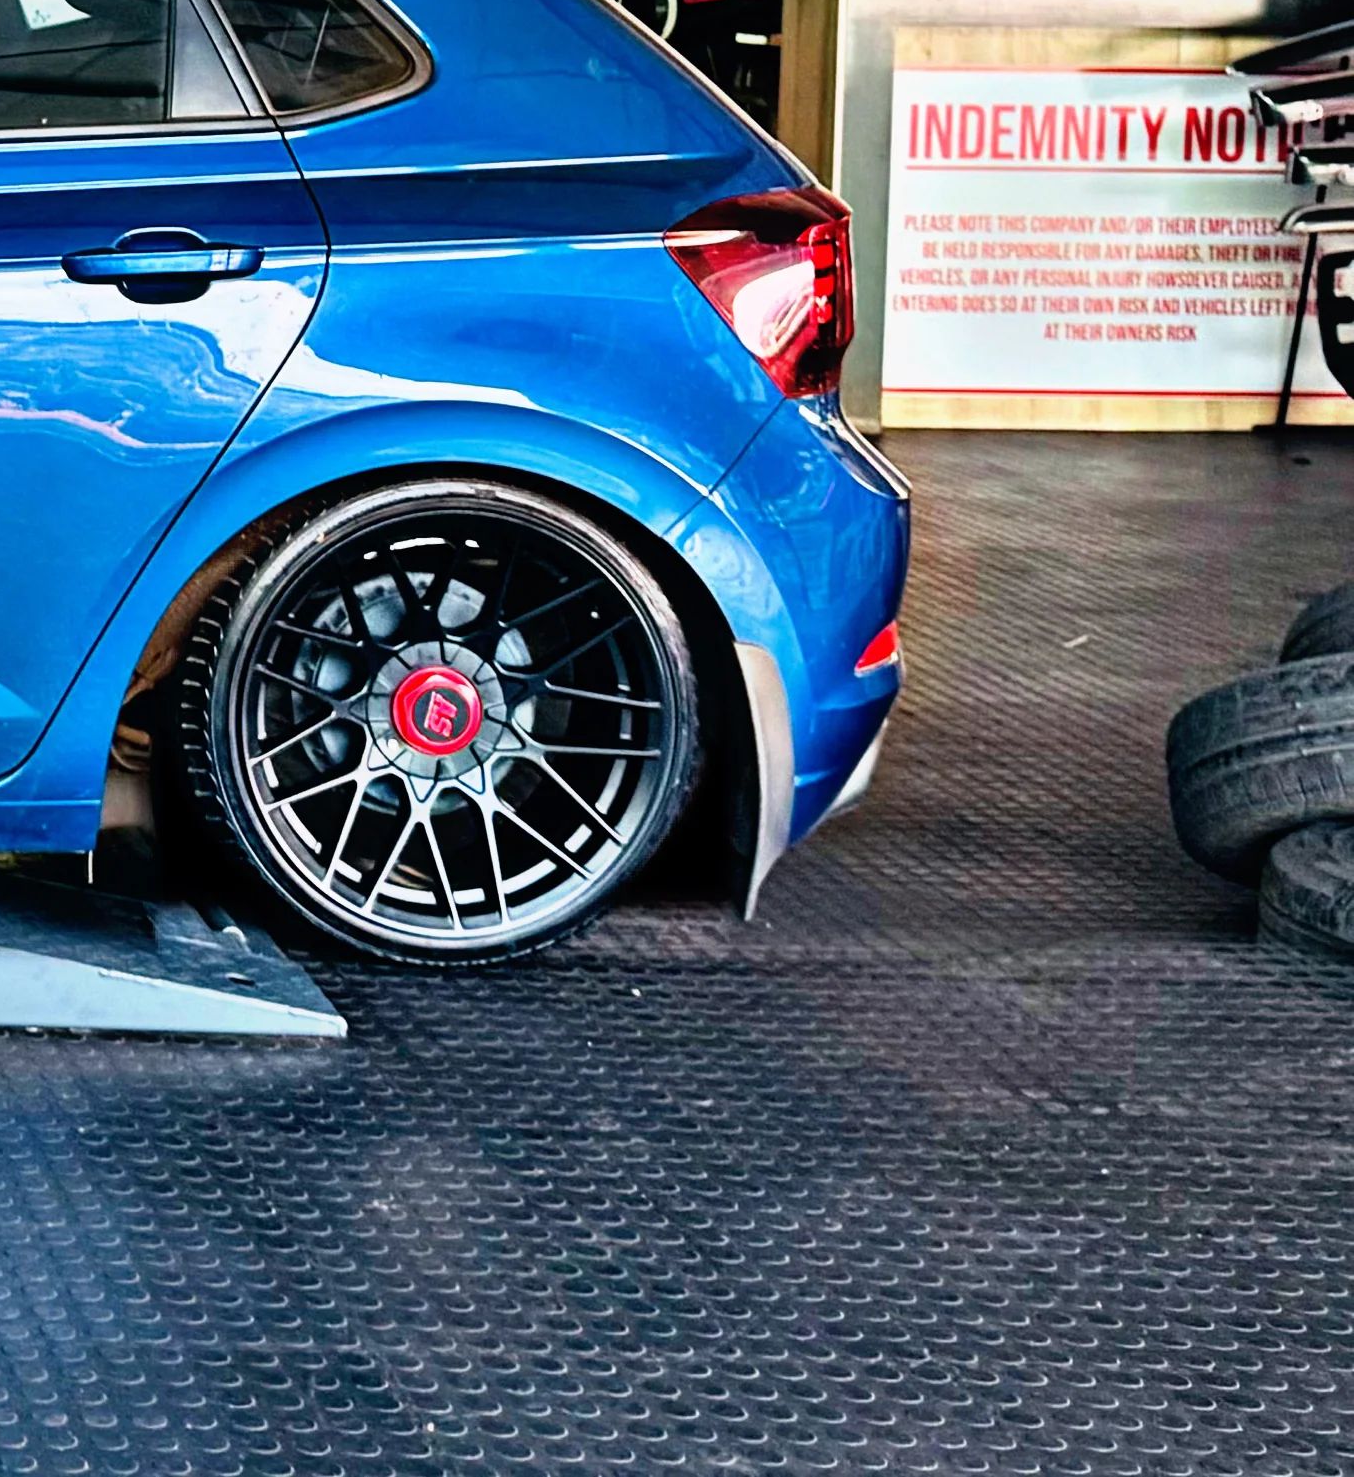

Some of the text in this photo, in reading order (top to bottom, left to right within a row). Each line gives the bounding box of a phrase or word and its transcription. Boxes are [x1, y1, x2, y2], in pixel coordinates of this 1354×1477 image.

[908, 103, 1168, 162] INDEMNITY
[904, 214, 953, 232] PLEASE
[958, 214, 992, 233] NOTE
[997, 215, 1026, 233] THIS
[1031, 215, 1095, 234] COMPANY
[1100, 216, 1153, 234] AND/OR
[1157, 216, 1195, 235] THEIR
[922, 241, 938, 259] BE
[943, 241, 977, 259] HELD
[982, 241, 1071, 260] RESPONSIBLE
[1075, 242, 1101, 260] FOR
[1105, 243, 1131, 260] ANY
[1209, 244, 1248, 262] THEFT
[1253, 245, 1271, 262] OR
[970, 268, 988, 286] OR
[992, 269, 1019, 286] ANY
[1023, 269, 1091, 288] PERSONAL
[1096, 270, 1141, 288] INJURY
[1146, 270, 1228, 289] HOWSOEVER
[893, 295, 958, 313] ENTERING
[962, 295, 997, 314] DOES
[1000, 295, 1018, 313] SO
[1021, 296, 1037, 313] AT
[1042, 296, 1079, 315] THEIR
[1084, 297, 1114, 315] OWN
[1118, 297, 1149, 315] RISK
[1153, 297, 1180, 315] AND
[1184, 298, 1246, 316] VEHICLES
[1251, 298, 1282, 316] LEFT
[1043, 323, 1197, 341] AT THEIR OWNERS RISK
